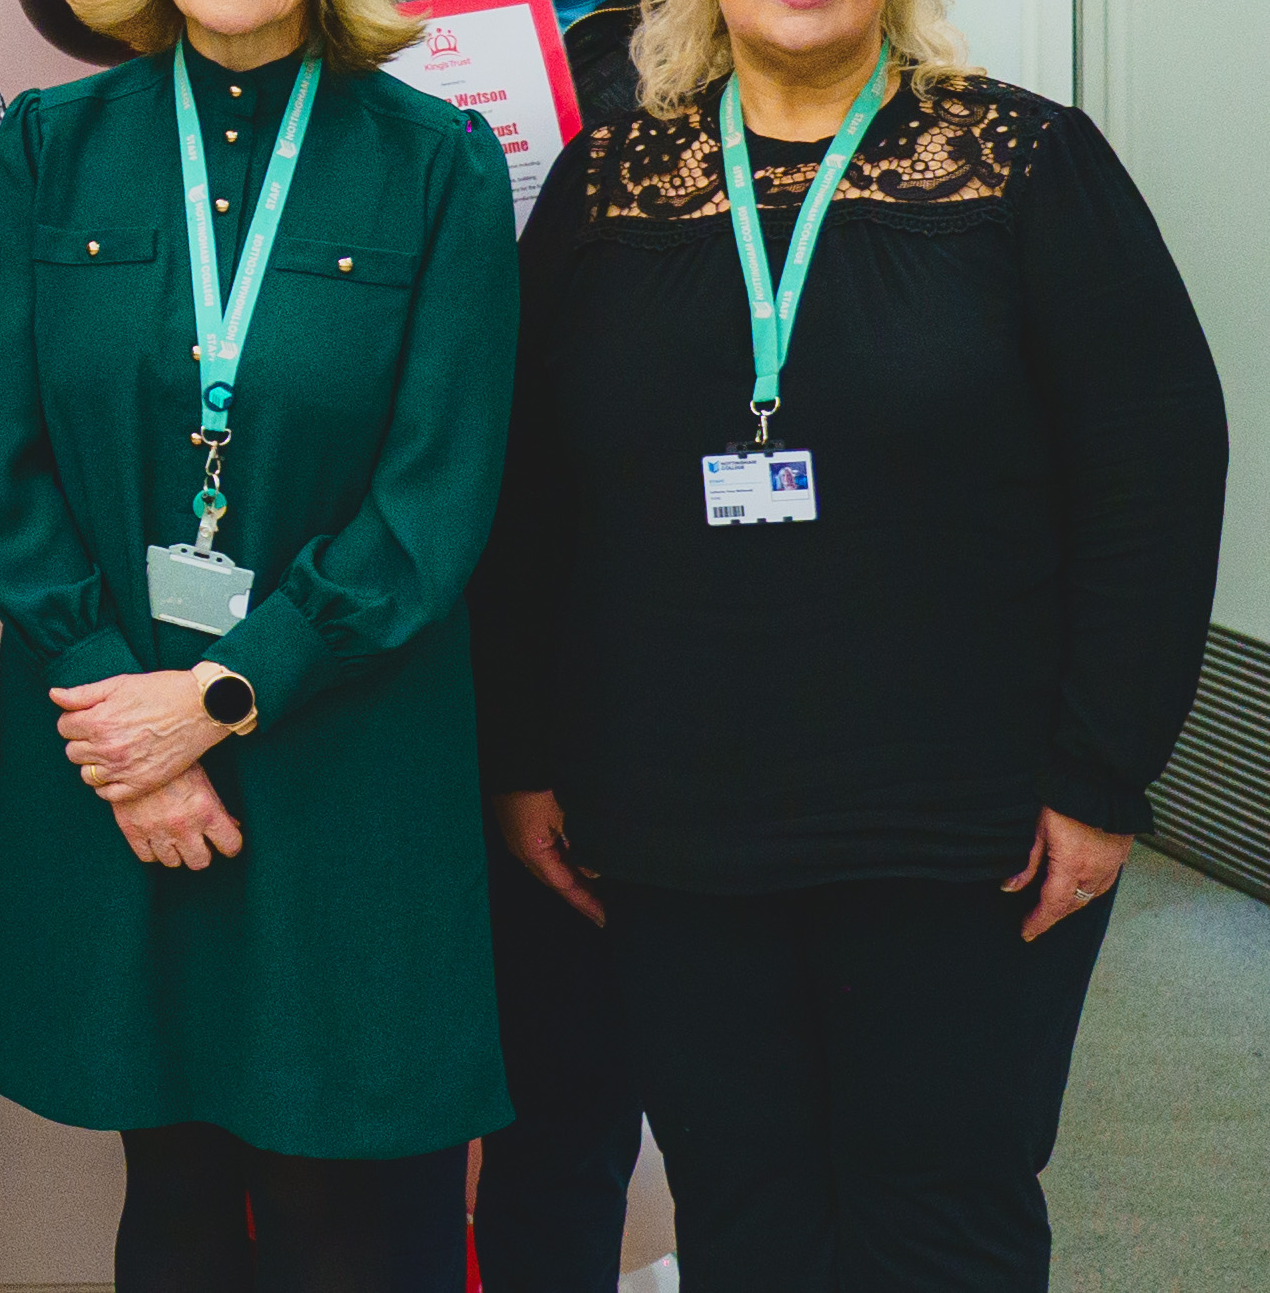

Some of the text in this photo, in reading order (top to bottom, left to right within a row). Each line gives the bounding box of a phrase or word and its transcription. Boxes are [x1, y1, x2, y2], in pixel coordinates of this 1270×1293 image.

[454, 89, 507, 107] Watson
[846, 112, 865, 136] STAFF
[185, 133, 198, 161] STAFF
[732, 164, 746, 189] STAFF
[264, 181, 282, 210] STAFF
[793, 167, 836, 265] NOTTINGHAM COLLEGE
[193, 201, 215, 307] NOTTINGHAM COLLEGE
[737, 205, 765, 301] NOTTINGHAM COLLEGE
[225, 234, 264, 342] NOTTINGHAM COLLEGE
[778, 290, 794, 320] STAFF
